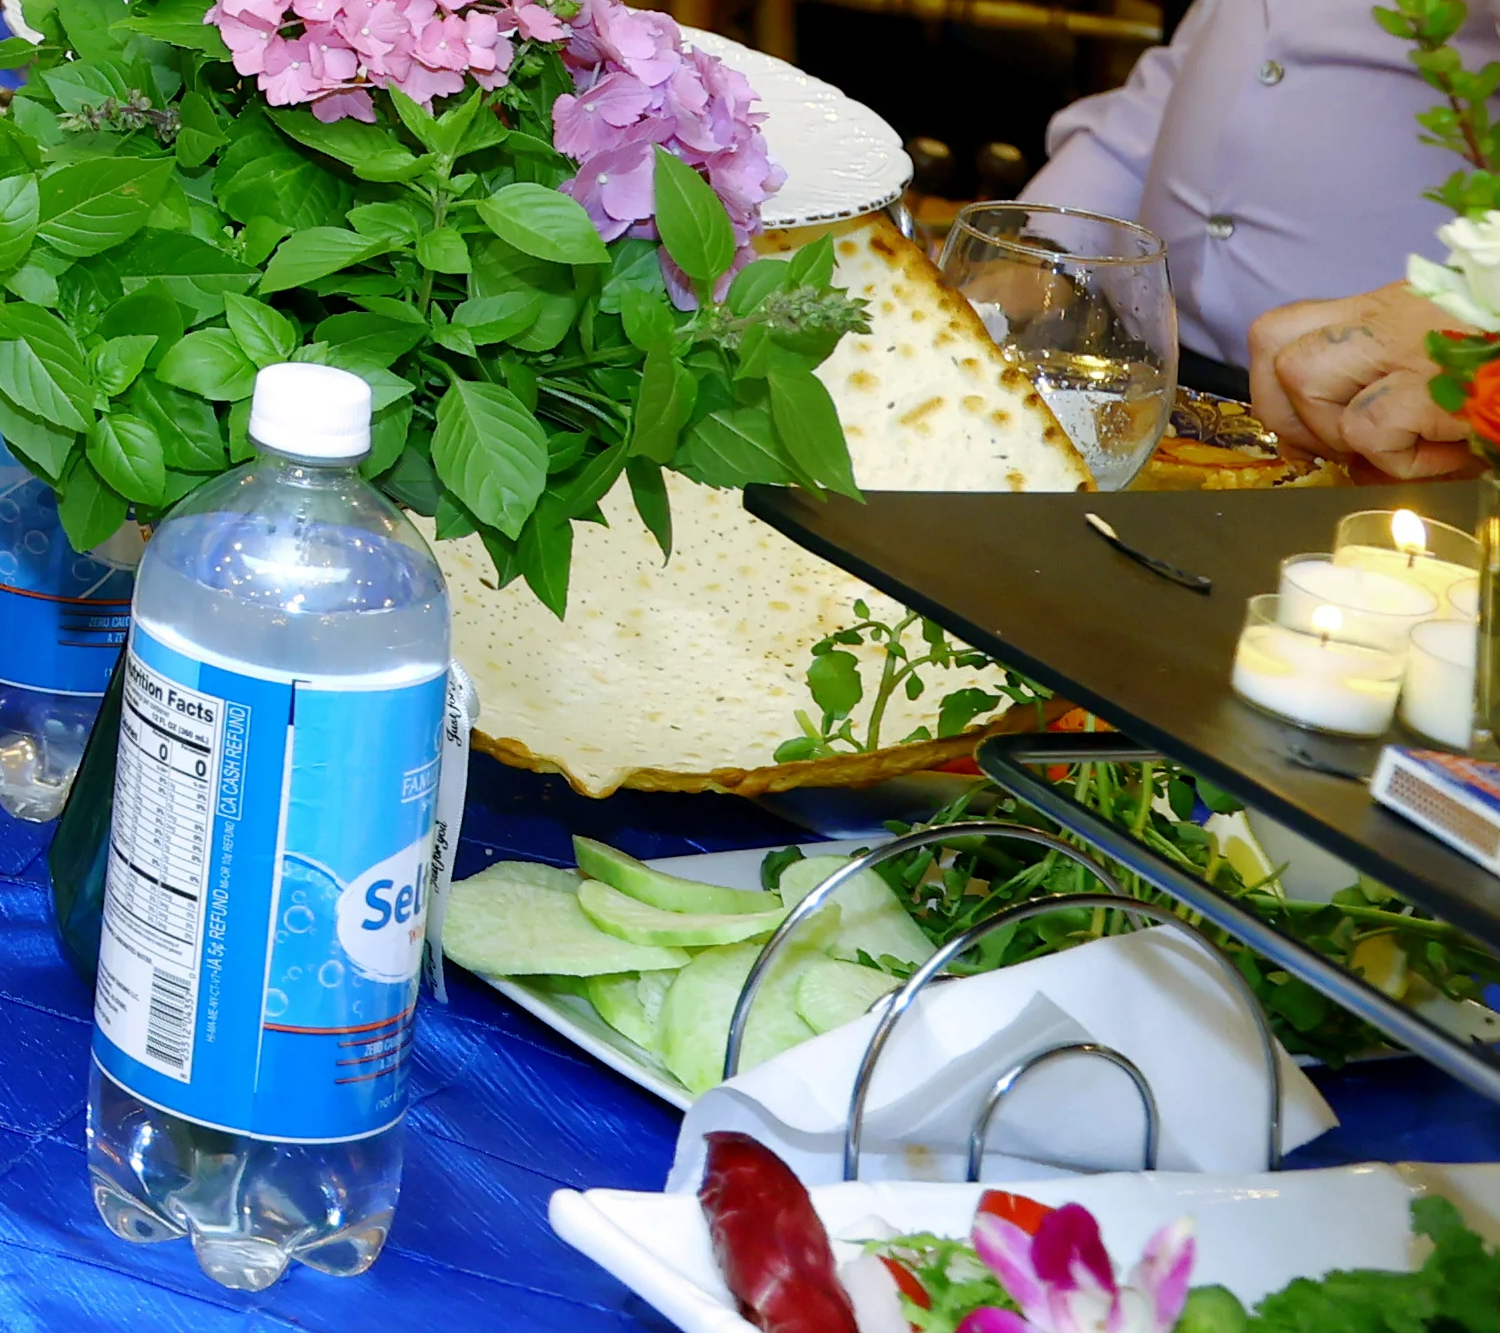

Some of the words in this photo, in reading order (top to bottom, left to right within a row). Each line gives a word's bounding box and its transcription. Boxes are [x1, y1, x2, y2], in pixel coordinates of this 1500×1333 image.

[168, 688, 214, 723] Facts
[225, 707, 246, 759] REFUND
[159, 743, 168, 761] 0
[195, 759, 206, 777] 0
[222, 759, 241, 795] CASH
[220, 796, 238, 815] CA
[209, 888, 229, 941] REFUND
[222, 821, 235, 853] REFUND
